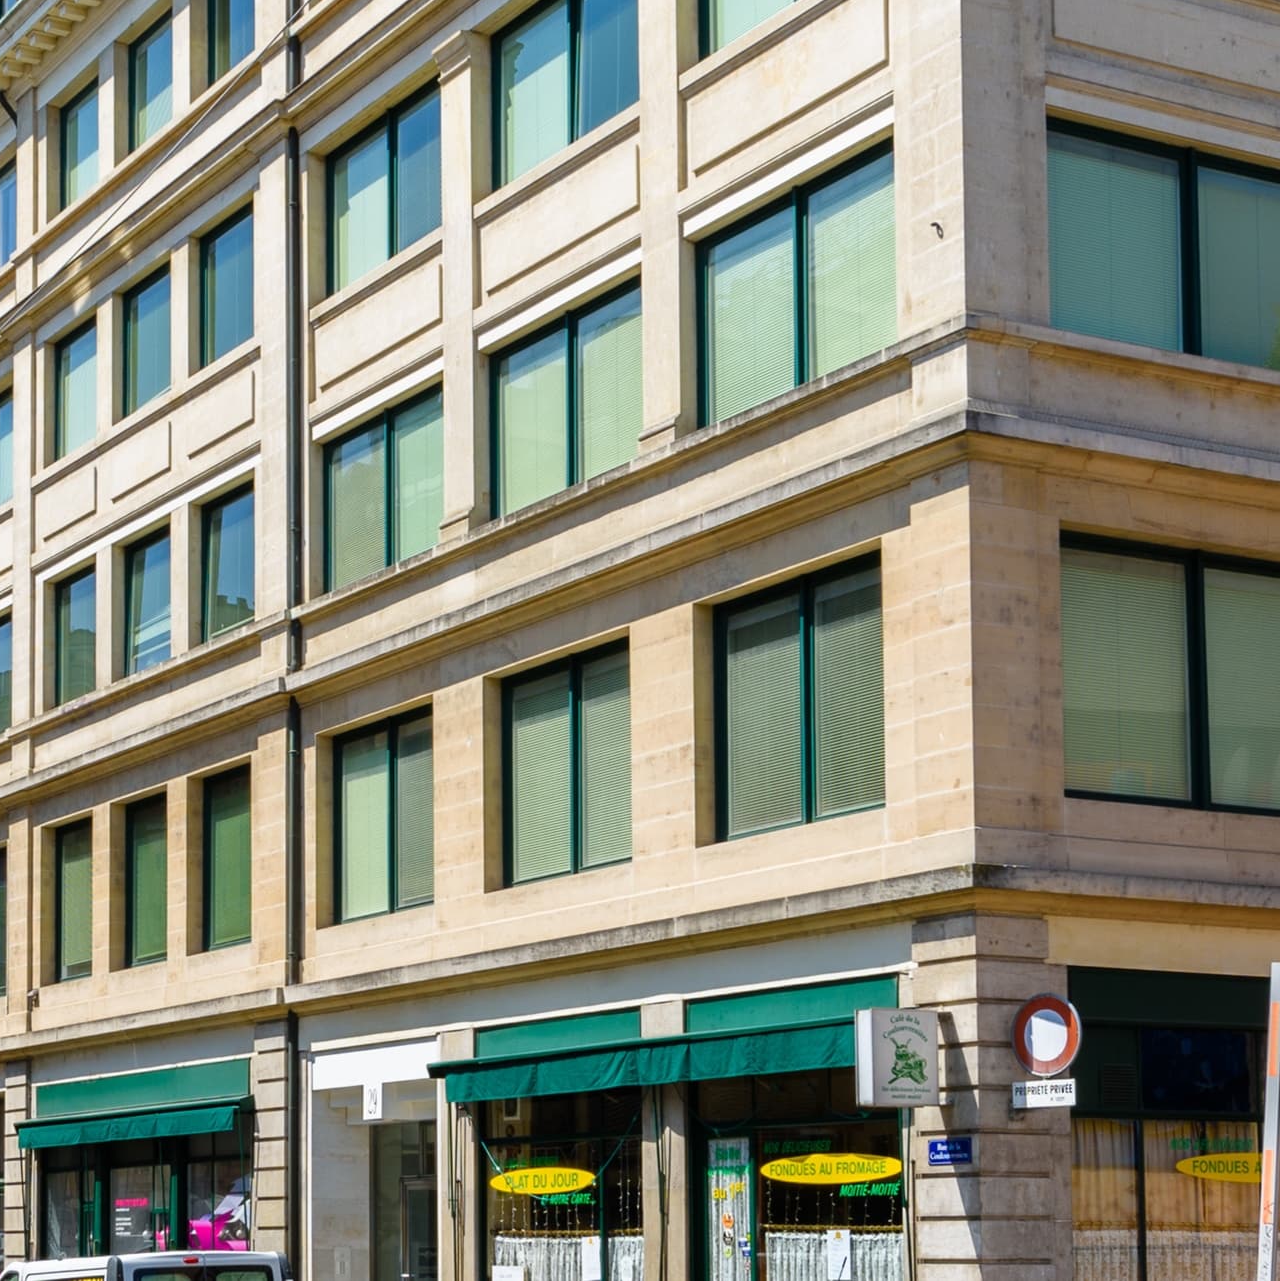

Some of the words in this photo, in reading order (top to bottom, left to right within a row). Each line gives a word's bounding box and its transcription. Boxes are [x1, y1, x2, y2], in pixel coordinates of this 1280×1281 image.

[368, 1088, 378, 1115] 29
[937, 1143, 947, 1151] Rue
[769, 1163, 816, 1176] FONDUES
[819, 1162, 833, 1175] AU
[835, 1160, 887, 1175] FROMAGE
[1192, 1160, 1249, 1174] FONDUES
[506, 1175, 529, 1189] PLAT
[533, 1174, 547, 1188] DU
[551, 1173, 579, 1188] JOUR
[714, 1188, 727, 1199] au
